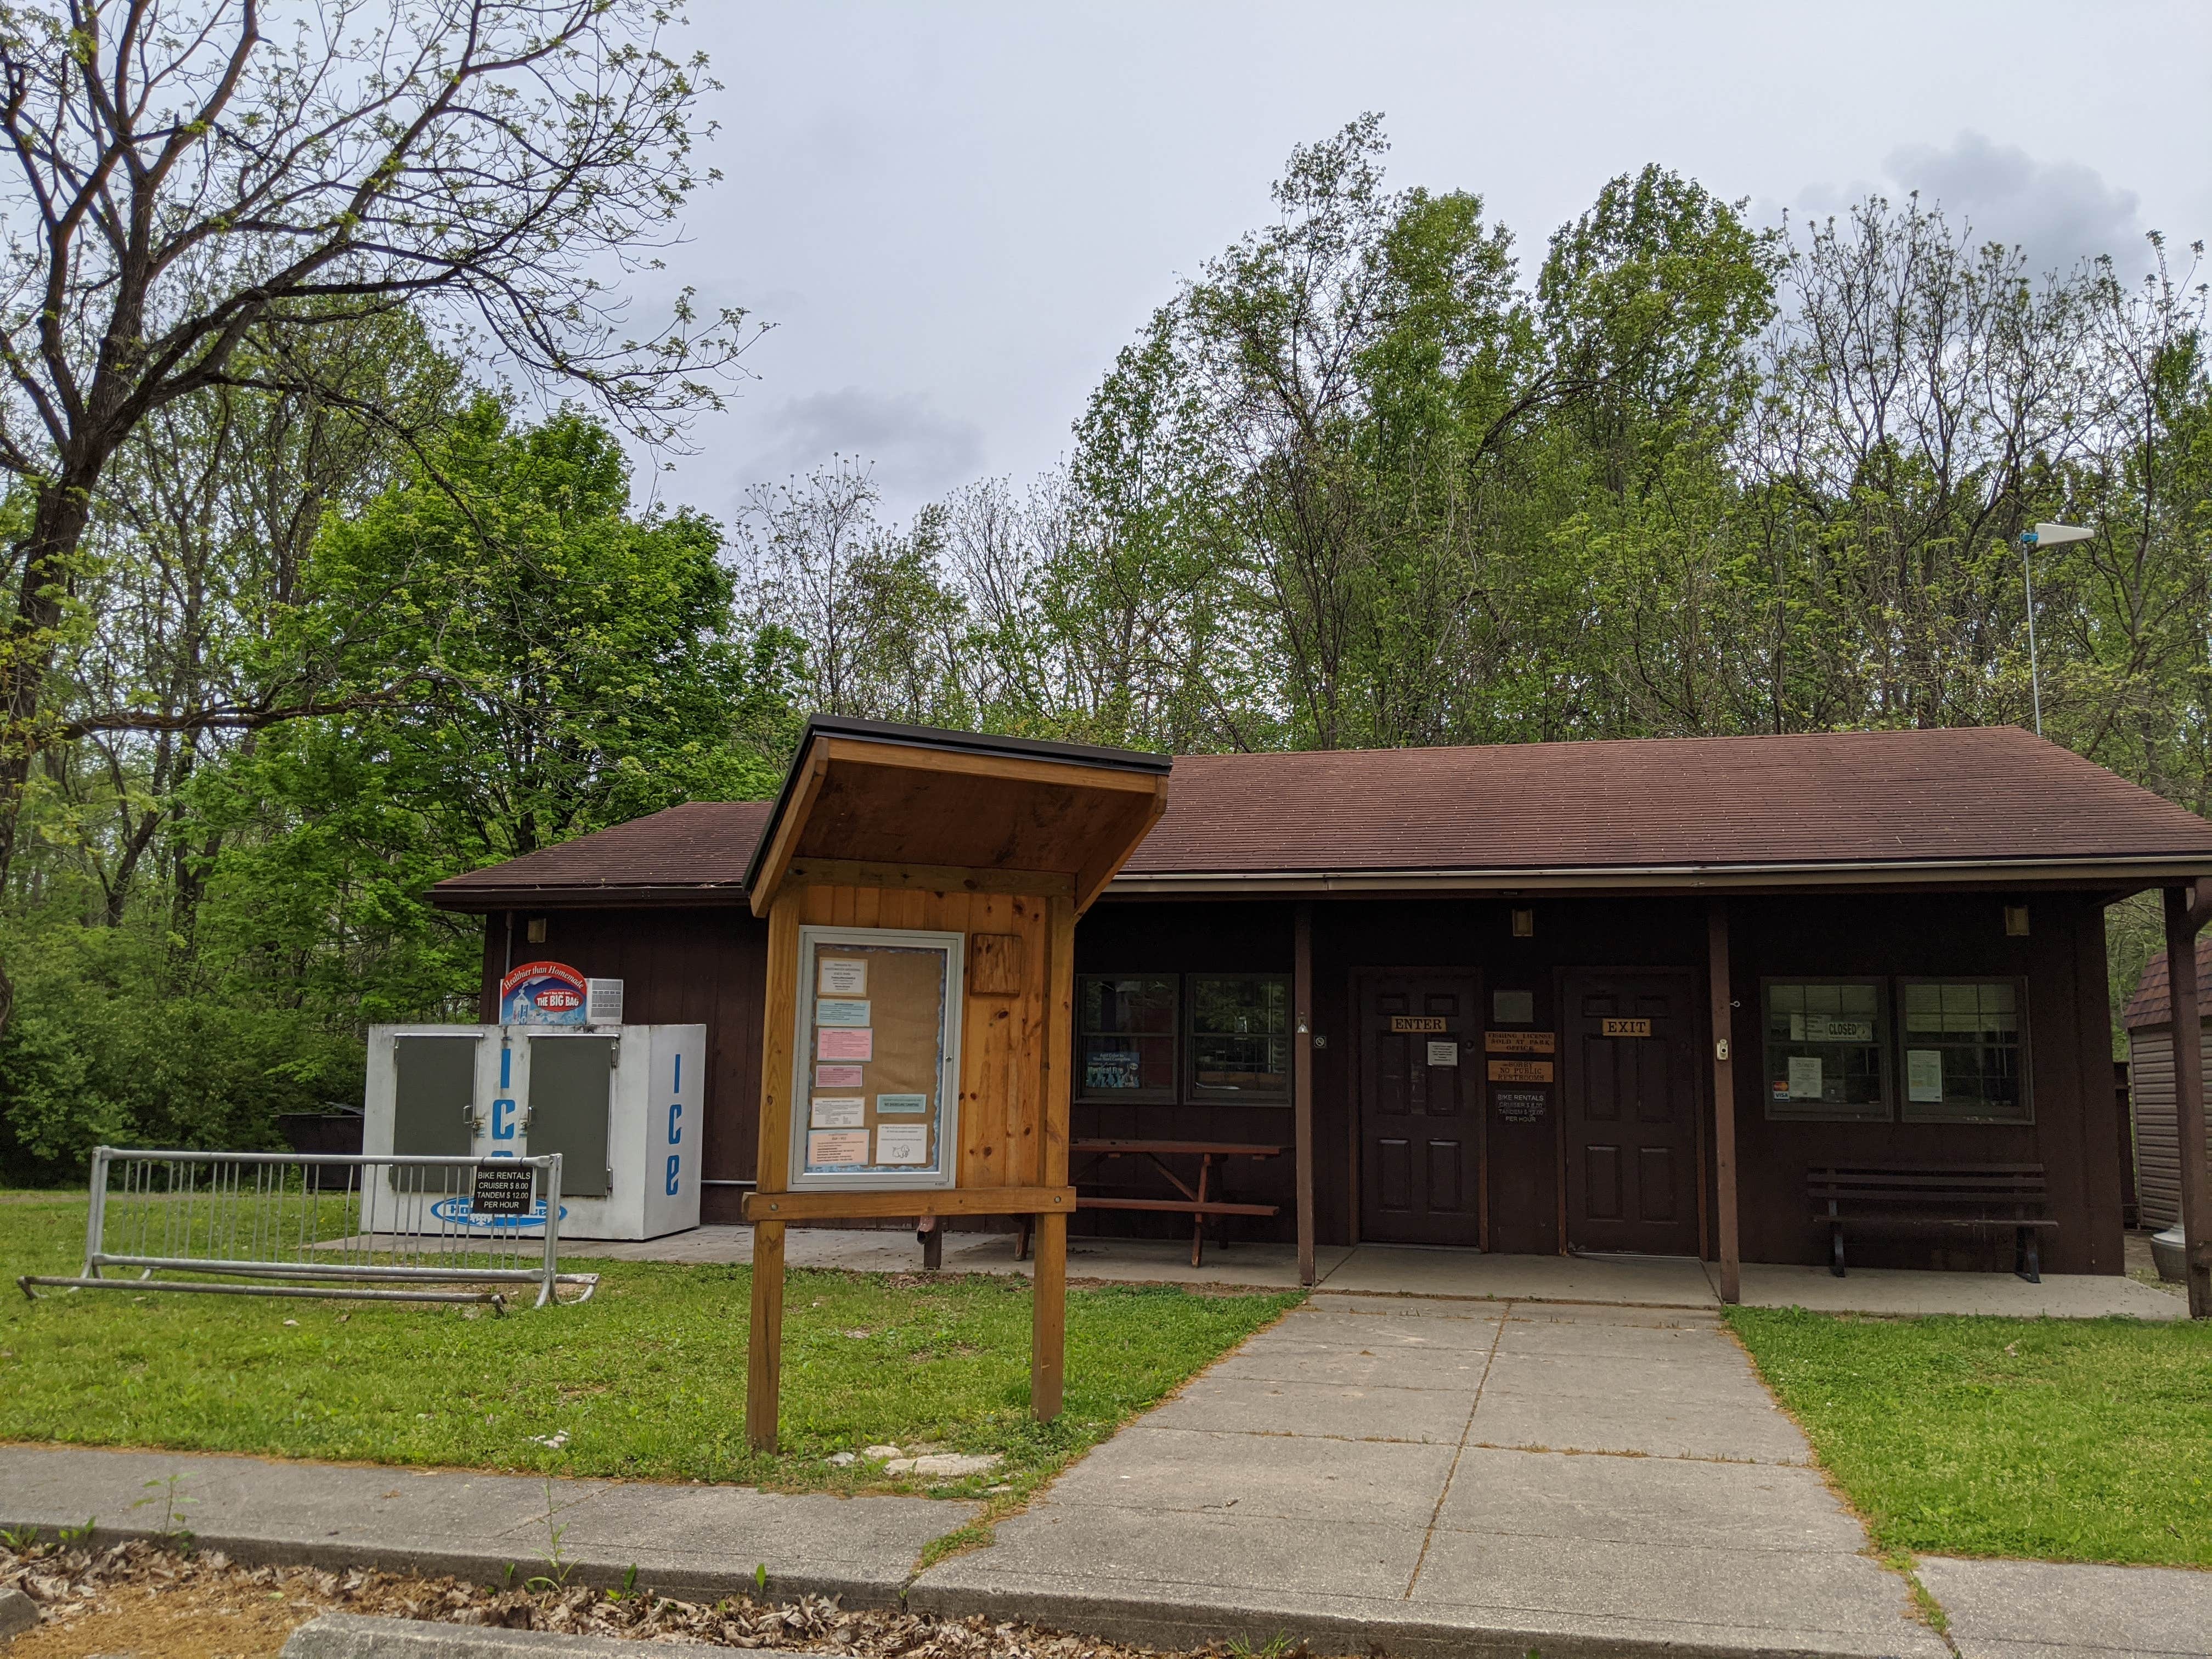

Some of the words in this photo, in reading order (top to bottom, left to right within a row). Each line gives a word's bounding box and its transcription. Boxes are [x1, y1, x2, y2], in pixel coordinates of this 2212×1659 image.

[504, 969, 531, 990] Healthier
[533, 966, 547, 975] than
[549, 966, 584, 989] Homemade
[537, 997, 548, 1007] THE
[550, 995, 564, 1007] BIG
[566, 997, 579, 1006] BAG
[1395, 1018, 1442, 1030] ENTER
[1607, 1022, 1646, 1032] EXIT
[1829, 1023, 1857, 1036] CLOSED
[510, 1182, 514, 1190] $
[506, 1191, 511, 1199] $
